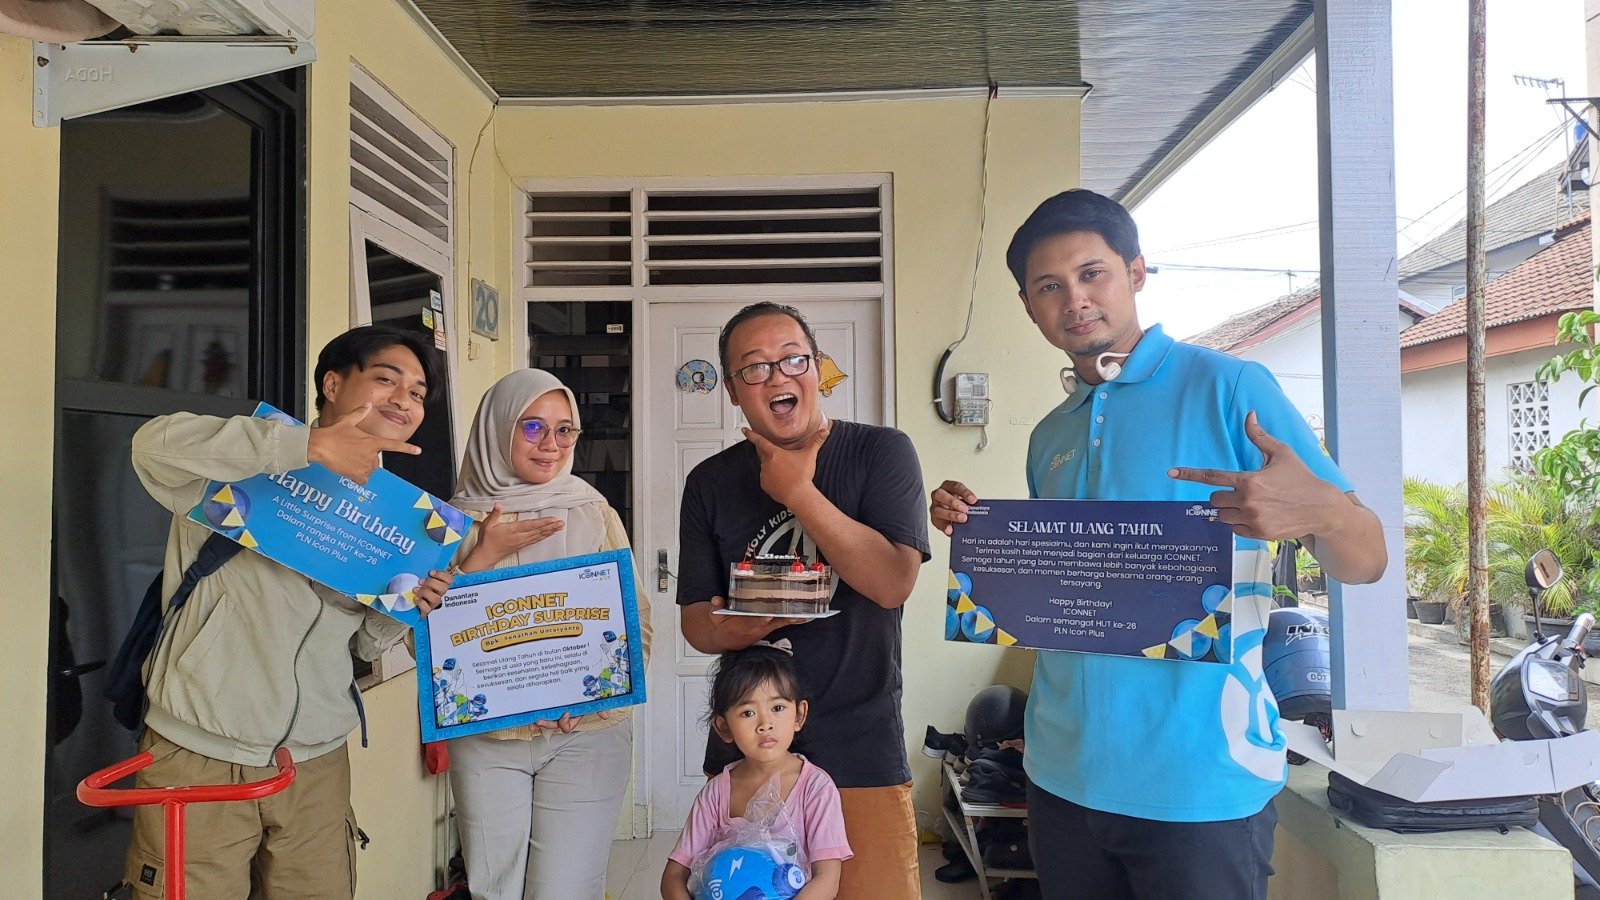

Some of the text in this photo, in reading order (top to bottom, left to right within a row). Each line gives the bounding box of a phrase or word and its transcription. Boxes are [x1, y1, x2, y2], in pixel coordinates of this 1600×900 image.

[476, 285, 497, 332] 20
[338, 476, 377, 500] ICONNET
[1186, 508, 1219, 517] ICONNE
[272, 496, 393, 560] A Little Surprise from ICONNET
[335, 499, 416, 555] Birthday
[1008, 520, 1163, 536] SELAMAT ULANG TAHUN
[276, 509, 378, 565] Dalam rangka HUT ke-26
[745, 525, 766, 557] HOLY
[962, 537, 977, 545] Hari
[987, 538, 1014, 546] adalah
[1031, 539, 1072, 549] spesialmu,
[1091, 541, 1111, 549] kami
[1112, 541, 1133, 551] ingin
[1134, 542, 1149, 550] ikut
[1151, 544, 1219, 553] merayakannya.
[295, 531, 349, 563] PLN Icon Plus
[975, 546, 1202, 562] Terima kasih telah menjadi bagian dari keluarga ICONNET.
[961, 555, 1218, 574] Semoga tahun yang baru membawa lebih banyak kebahagiaan,
[579, 569, 610, 580] ICONNET
[1018, 567, 1033, 575] dan
[1034, 568, 1065, 576] momen
[1066, 569, 1105, 579] berharga
[1106, 571, 1144, 579] bersama
[1146, 574, 1203, 585] orang-orang
[1060, 578, 1102, 590] tersayang.
[444, 592, 479, 602] Danantara
[444, 598, 478, 608] Indonesia
[1049, 597, 1113, 610] Happy Birthday!
[485, 592, 568, 620] ICONNET
[1063, 608, 1098, 617] ICONNET
[450, 607, 610, 647] BIRTHDAY SURPRISE
[1025, 615, 1137, 630] Dalam semangat HUT ke-26
[1053, 627, 1105, 638] PLN Icon Plus
[517, 652, 537, 660] Tahun
[562, 643, 586, 652] Oktober
[475, 666, 501, 675] Semoga
[509, 661, 522, 669] usia
[522, 659, 539, 668] yang
[1310, 673, 1328, 681] DOT
